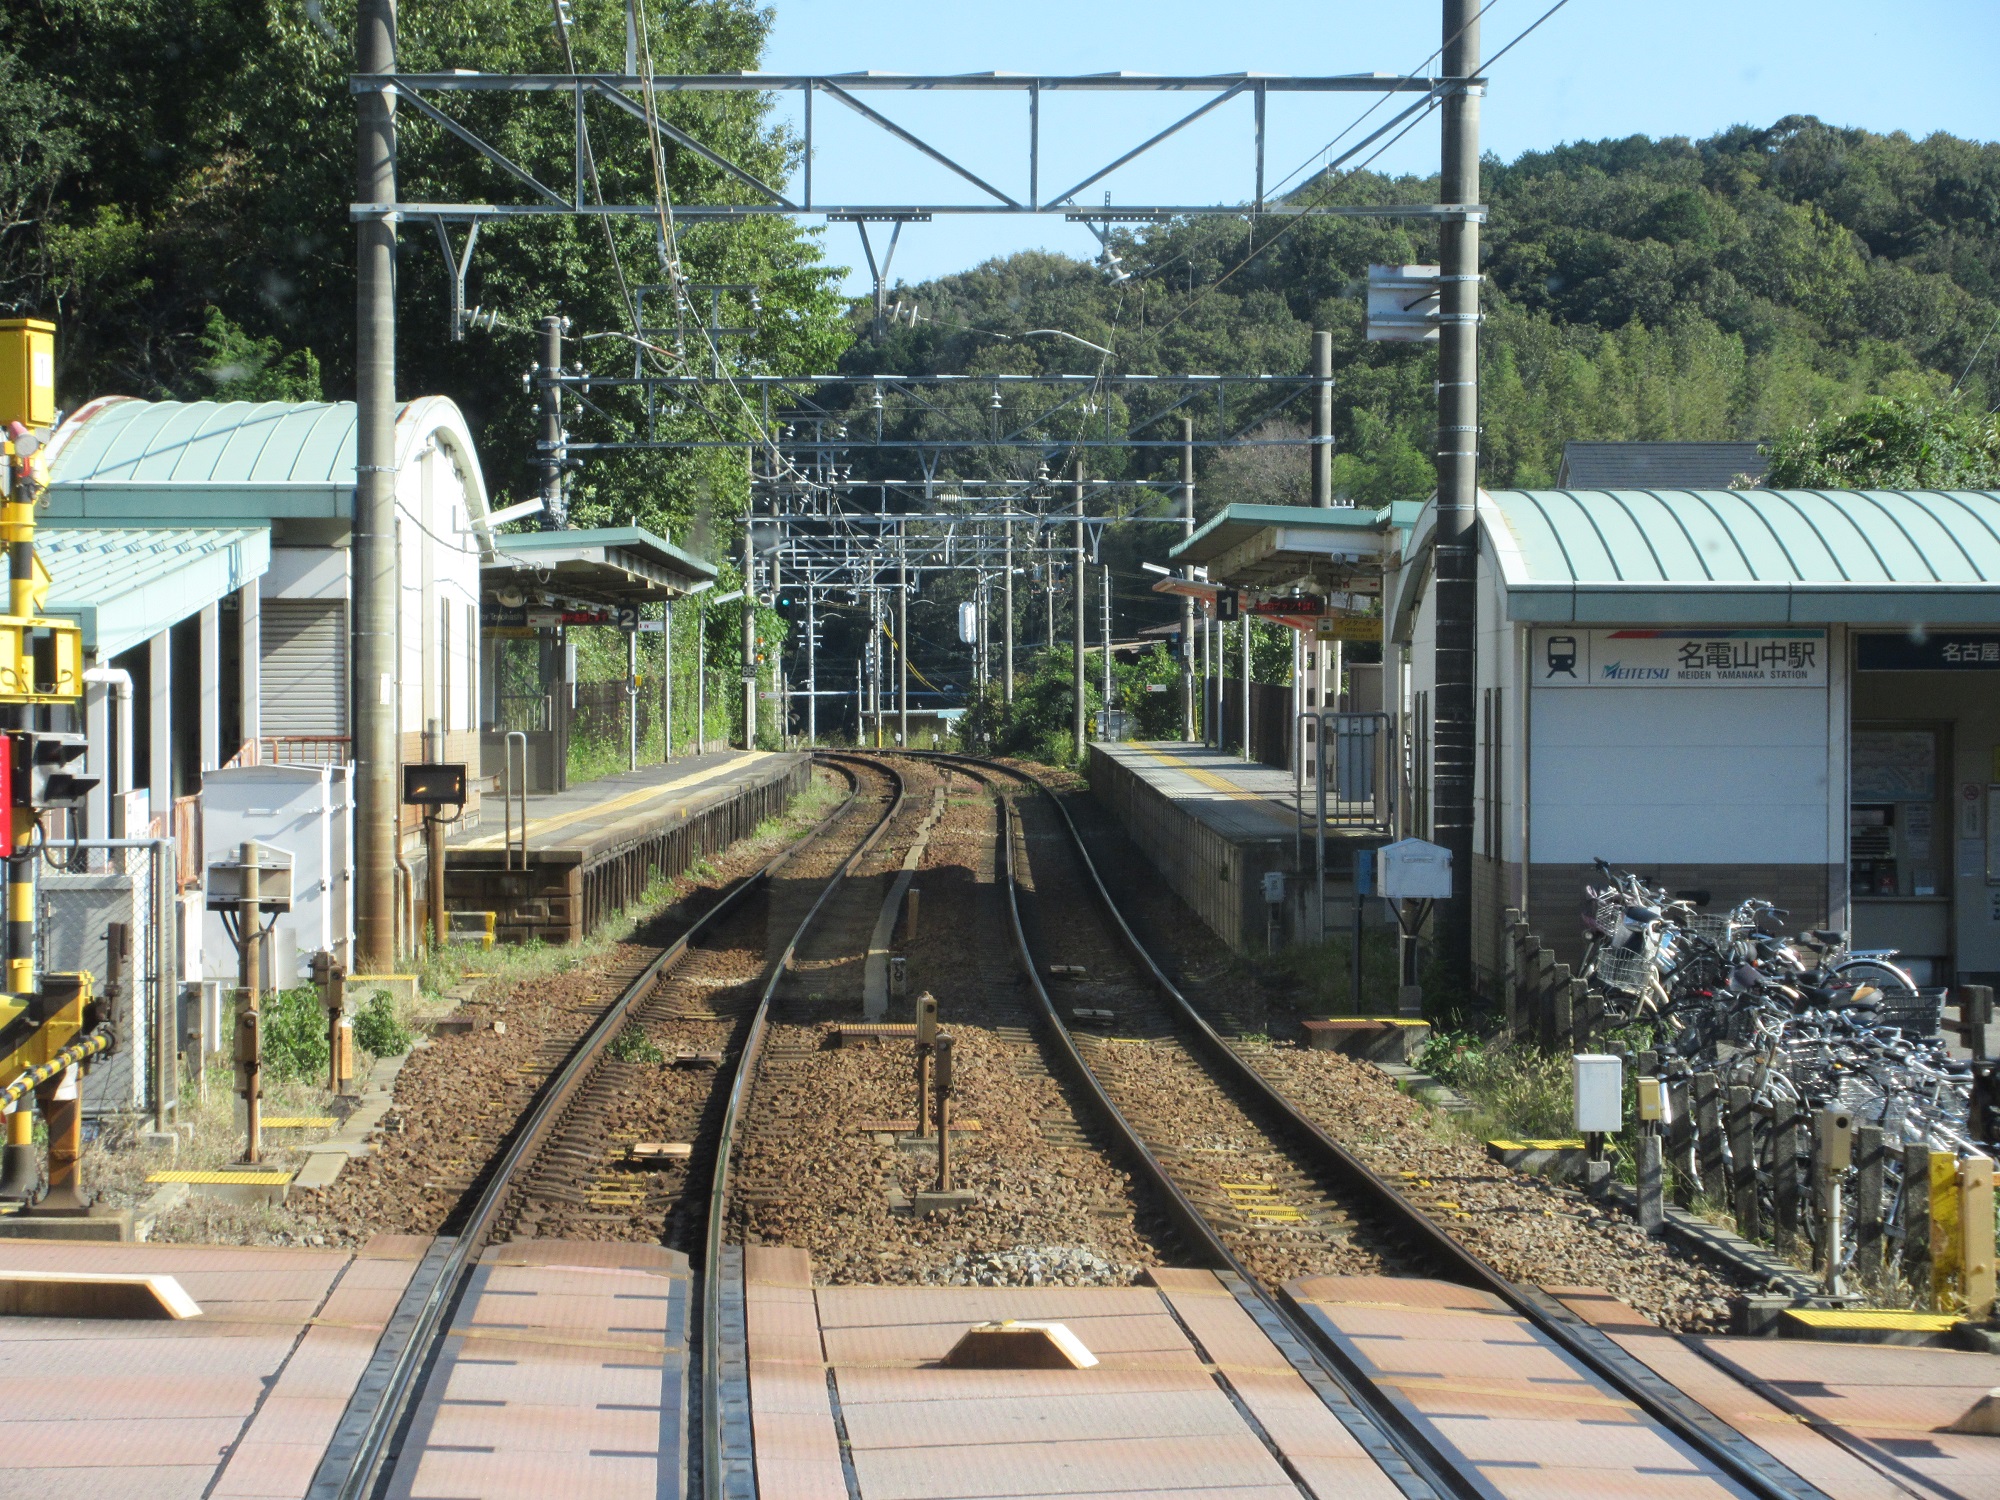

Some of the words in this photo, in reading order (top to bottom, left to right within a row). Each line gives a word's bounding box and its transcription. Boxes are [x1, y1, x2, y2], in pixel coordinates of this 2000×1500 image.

[1221, 596, 1232, 615] 1
[620, 609, 635, 627] 2
[1678, 641, 1816, 669] 名電山中駅
[1942, 642, 2000, 661] 名古屋
[742, 666, 755, 677] 85
[1602, 661, 1670, 680] MEITETSU
[1677, 670, 1712, 680] MEIDEN
[1716, 670, 1766, 680] YAMANAKA
[1770, 670, 1808, 680] STATION
